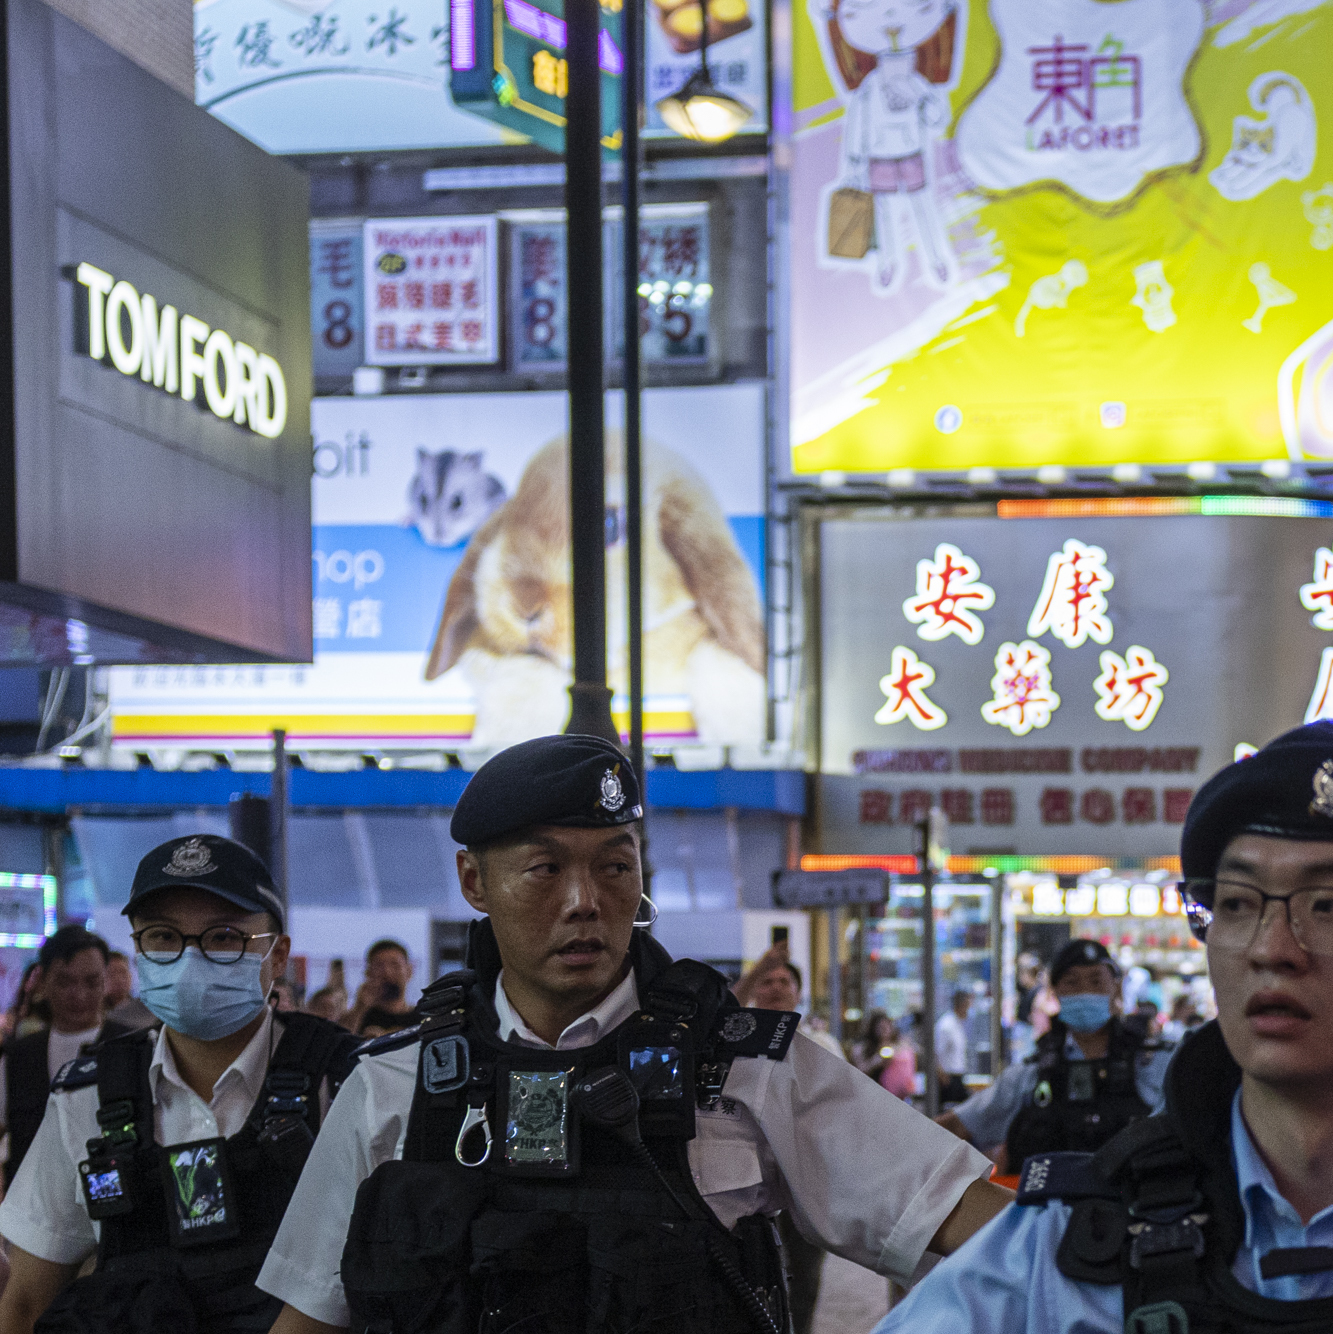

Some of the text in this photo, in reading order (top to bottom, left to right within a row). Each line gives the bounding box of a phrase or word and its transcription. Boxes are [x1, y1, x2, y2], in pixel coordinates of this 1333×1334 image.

[77, 261, 288, 439] TOM FORD
[903, 543, 1114, 648] 安康
[874, 640, 1170, 737] 大藥坊
